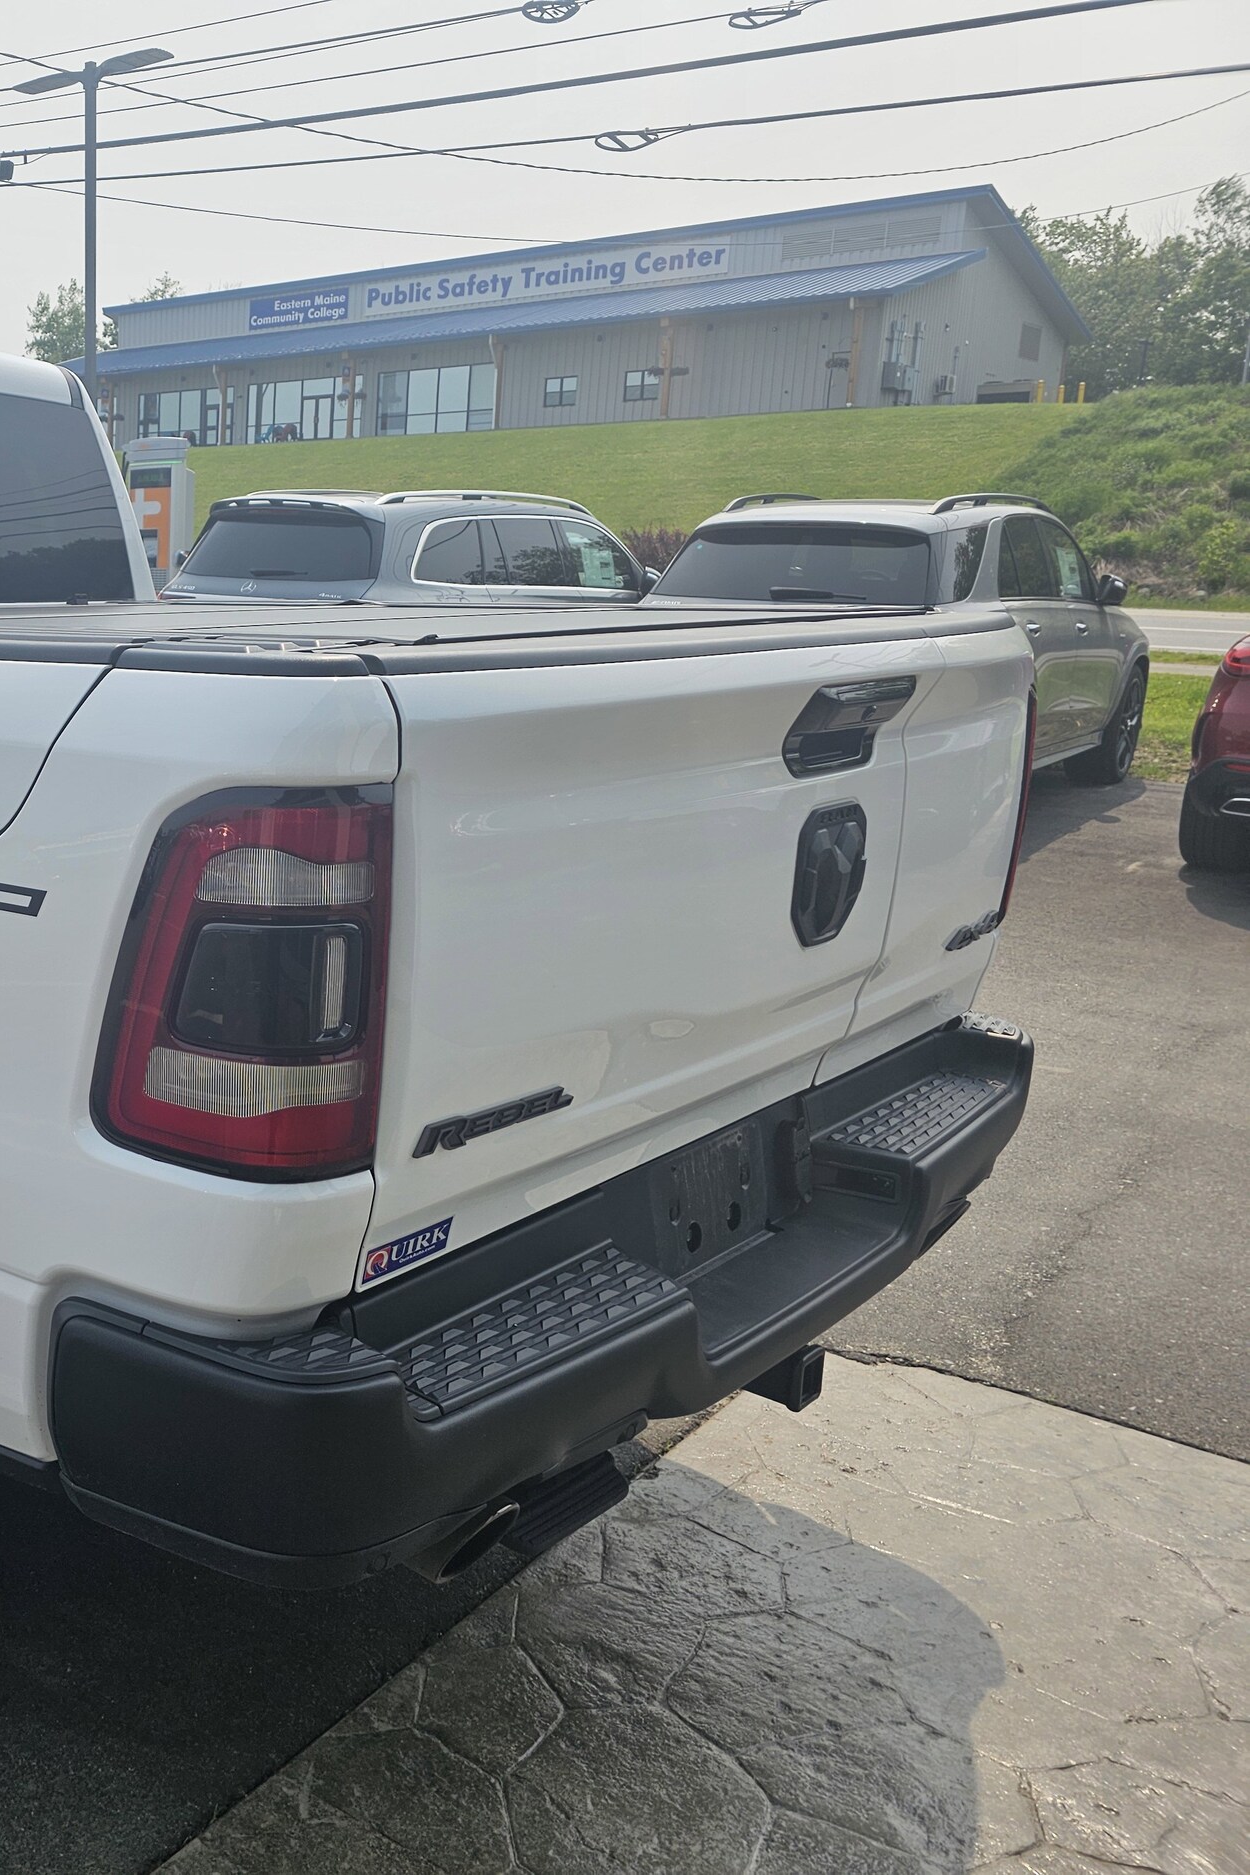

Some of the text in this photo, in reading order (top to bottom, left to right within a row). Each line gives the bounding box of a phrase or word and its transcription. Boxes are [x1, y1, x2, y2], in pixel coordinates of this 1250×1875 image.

[274, 293, 346, 311] Eastern Maine
[366, 247, 726, 308] Public Safety Training Center
[250, 306, 346, 326] Community College
[411, 1085, 575, 1159] REBEL
[365, 1222, 450, 1276] QUIRK
